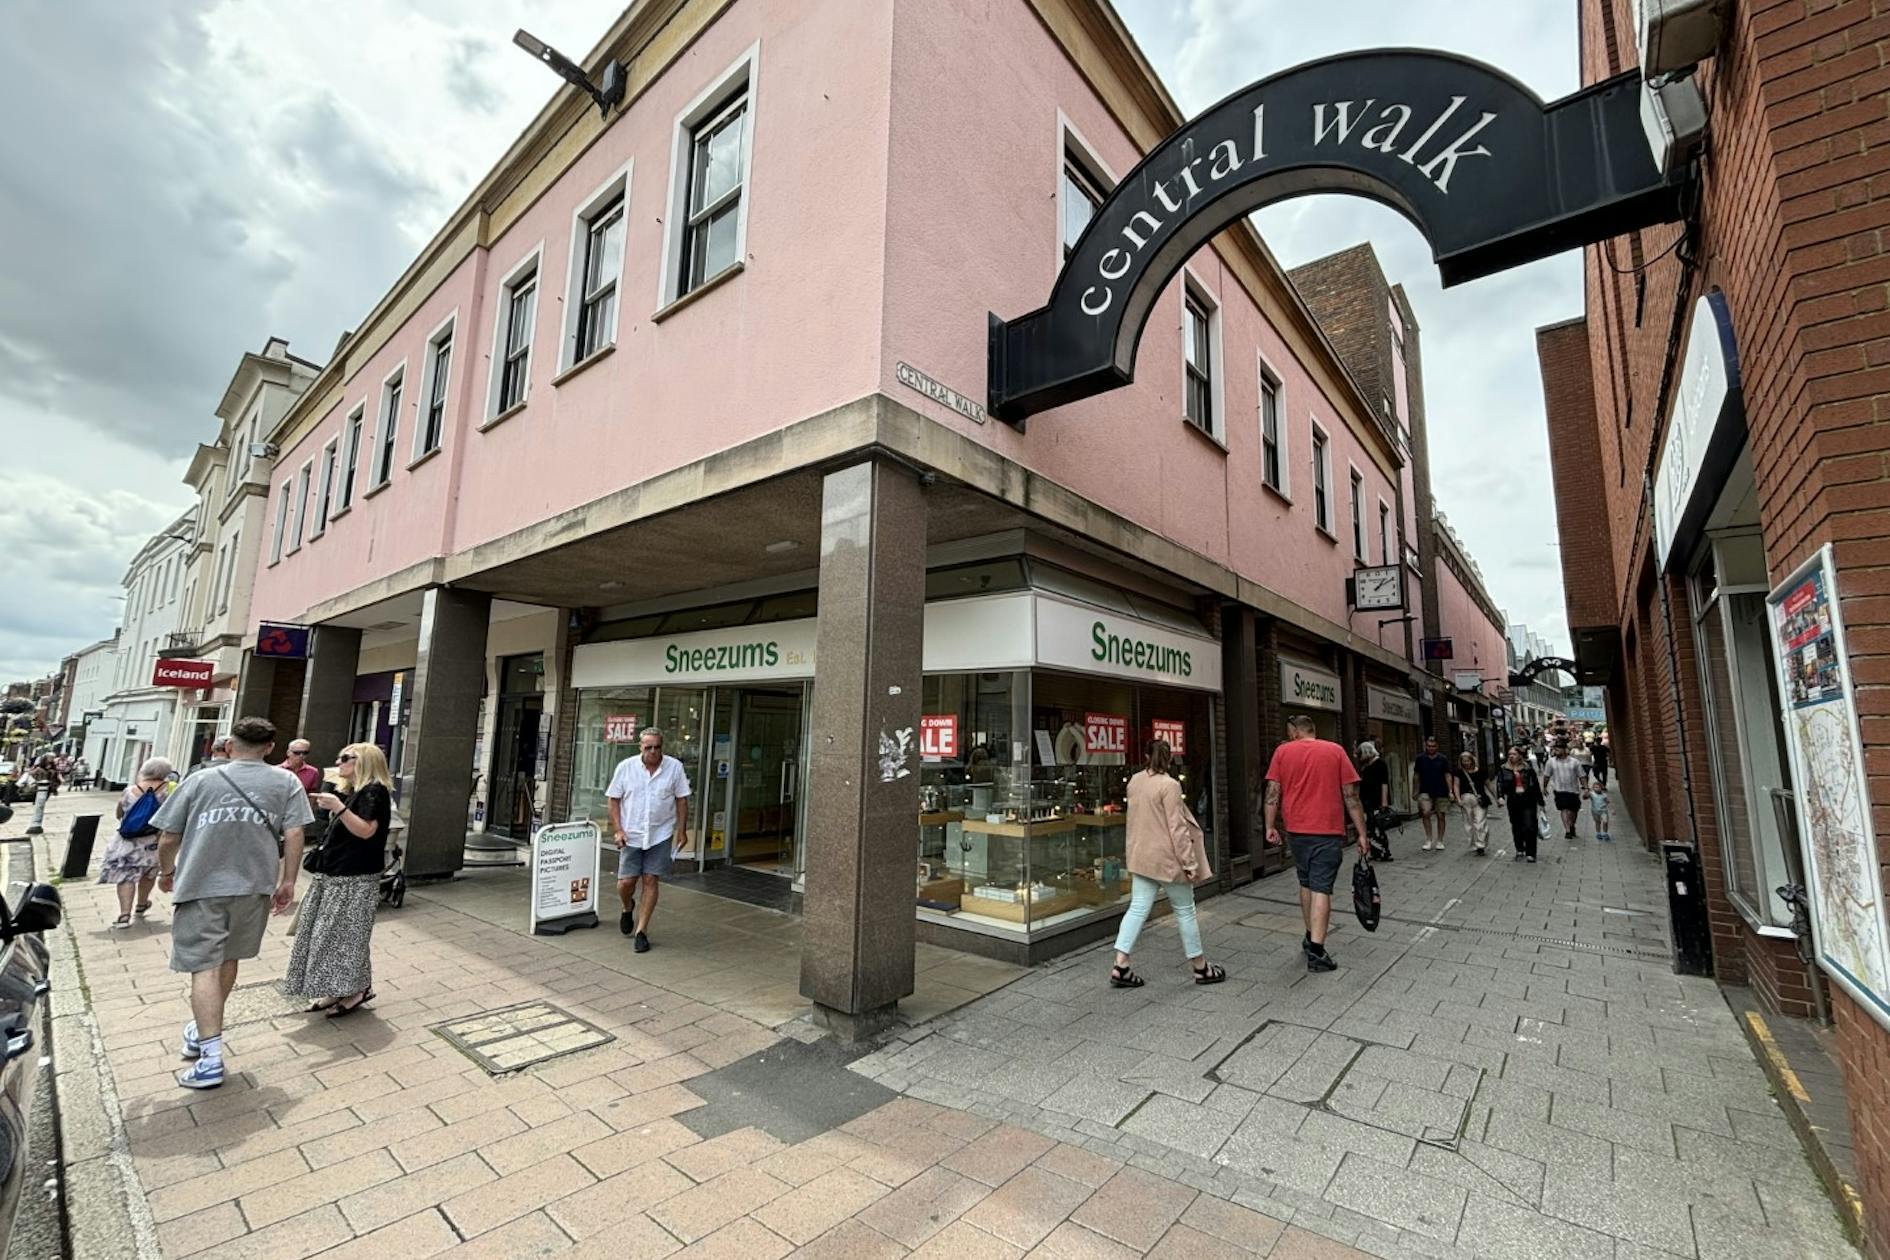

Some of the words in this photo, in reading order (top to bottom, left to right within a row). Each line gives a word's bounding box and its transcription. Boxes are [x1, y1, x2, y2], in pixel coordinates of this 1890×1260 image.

[1080, 103, 1266, 316] central
[1312, 95, 1498, 194] walk
[899, 365, 951, 405] CENTRAL
[954, 393, 984, 421] WALK
[665, 641, 779, 674] Sneezums
[1091, 621, 1192, 677] Sneezums
[157, 668, 209, 680] Iceland
[1294, 672, 1335, 704] Sneezums
[607, 723, 635, 740] SALE
[928, 719, 953, 727] DOWN
[920, 728, 953, 753] LE
[1087, 725, 1125, 750] SALE
[541, 829, 594, 844] Sneezums
